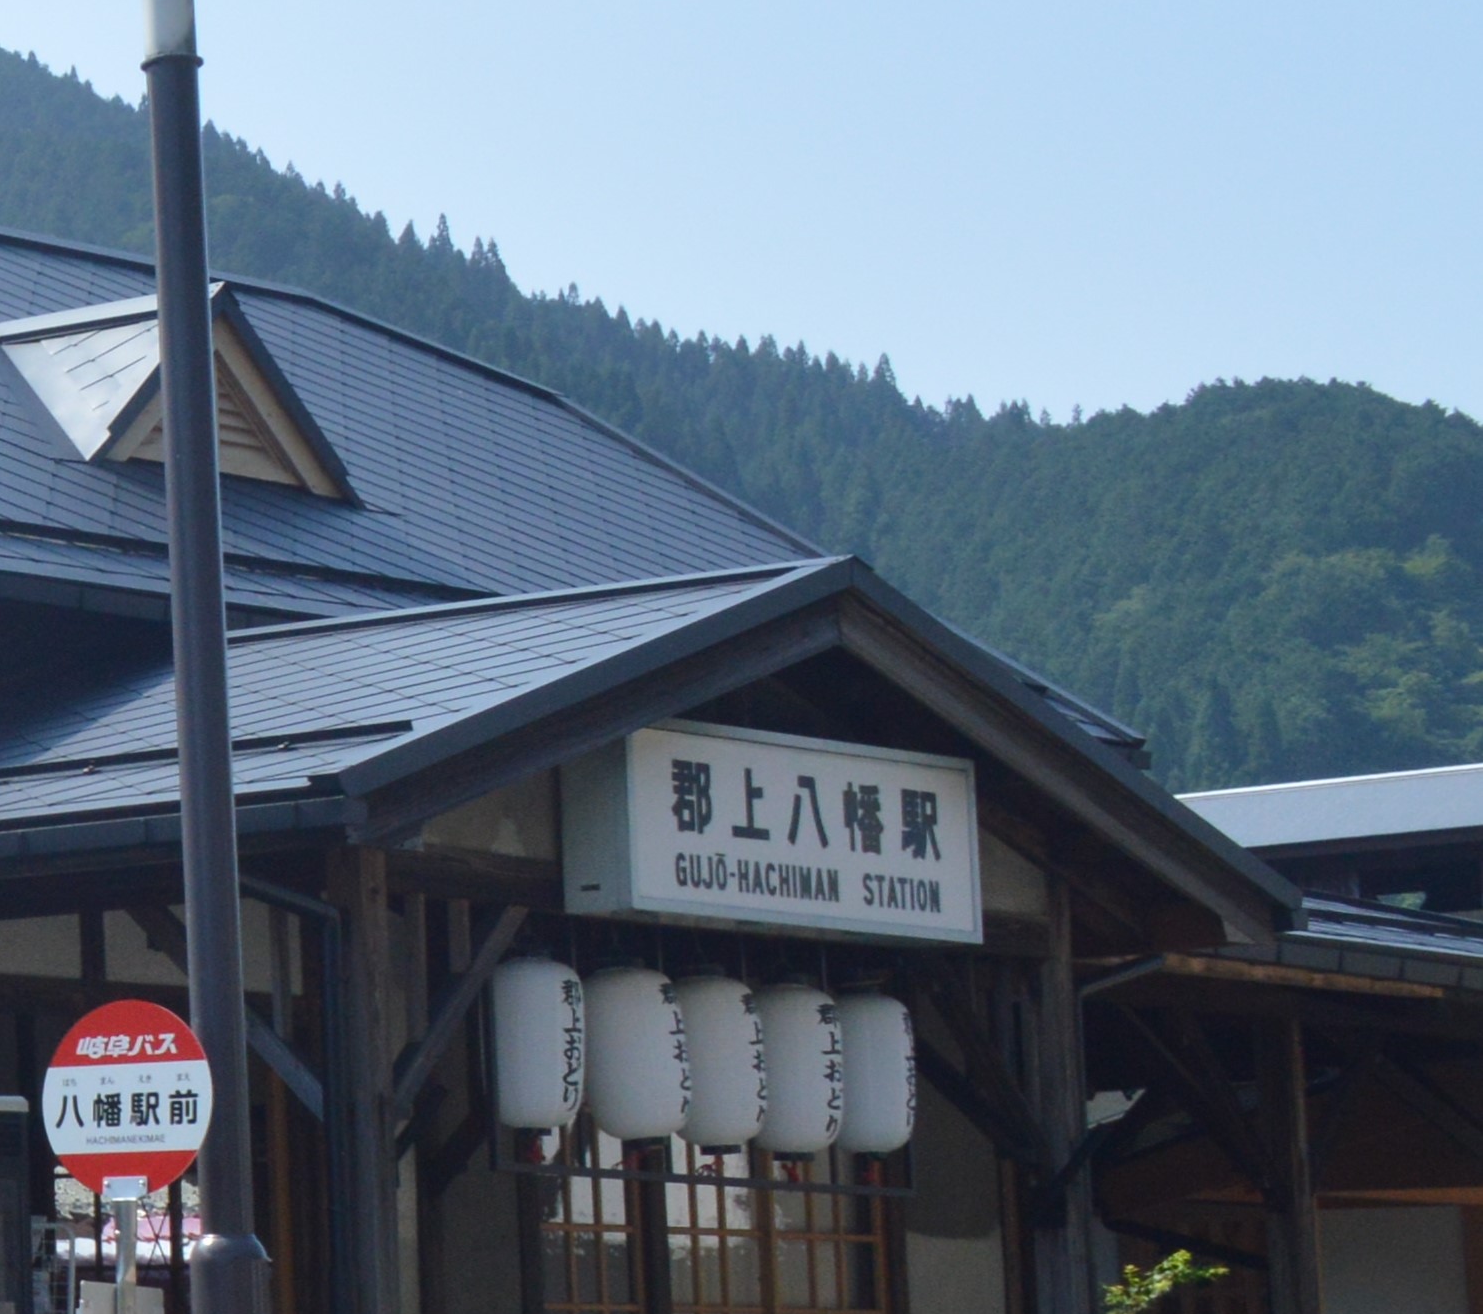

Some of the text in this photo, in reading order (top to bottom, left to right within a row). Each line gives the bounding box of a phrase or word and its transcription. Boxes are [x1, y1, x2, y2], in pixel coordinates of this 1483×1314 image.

[671, 759, 942, 862] 郡上八幡駅
[674, 852, 942, 914] GUJŌ-HACHIMAN STATION
[75, 1032, 178, 1059] 岐阜バス
[55, 1088, 199, 1129] 八幡駅前
[85, 1133, 166, 1145] HACHIMANEKIMAE
